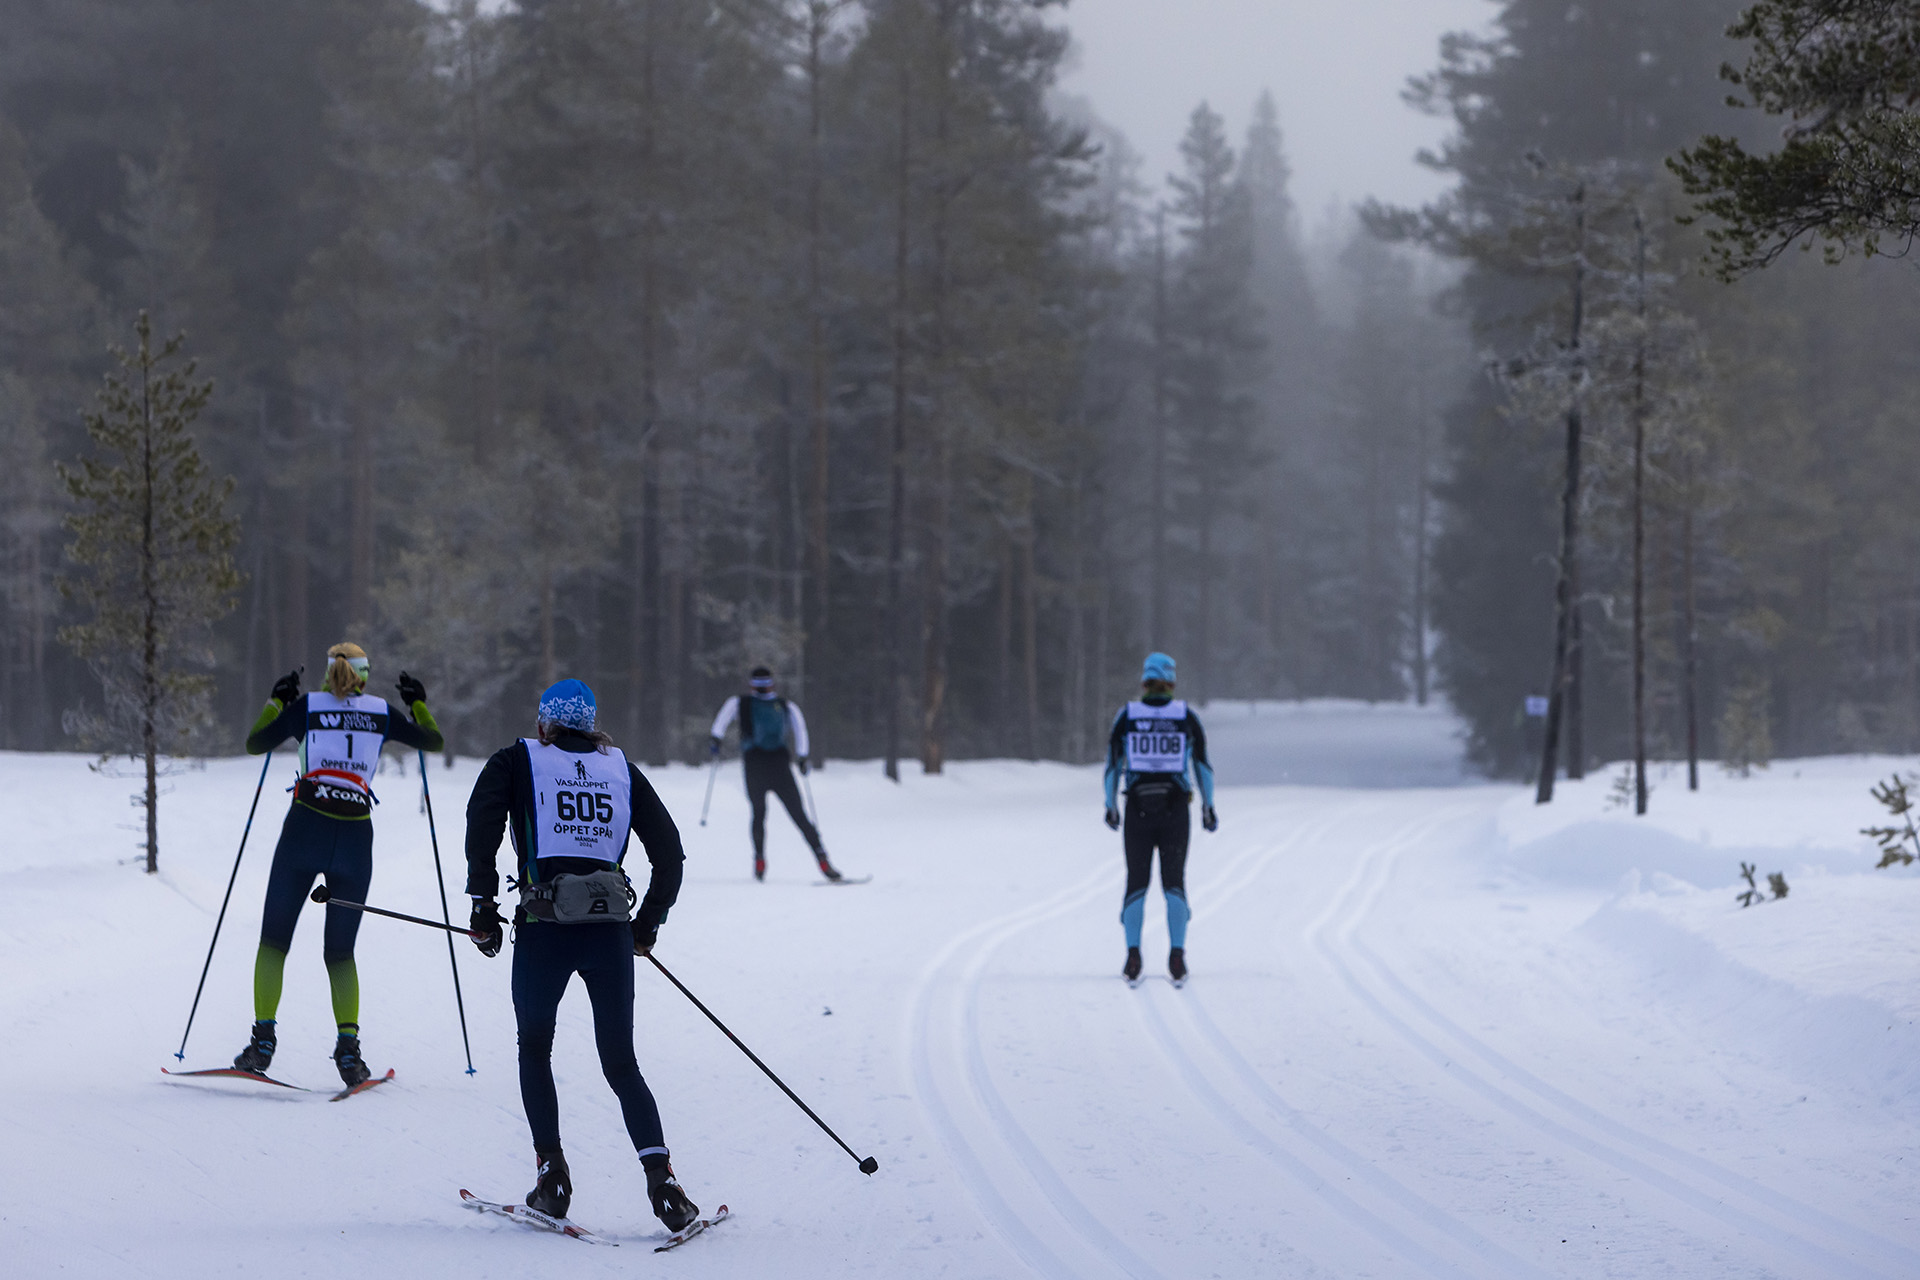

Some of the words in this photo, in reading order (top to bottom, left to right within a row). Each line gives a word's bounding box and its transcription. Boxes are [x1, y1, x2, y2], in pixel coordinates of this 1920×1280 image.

[343, 712, 371, 721] wibe
[343, 720, 377, 731] group
[344, 733, 353, 759] 1
[1132, 735, 1181, 755] 10108
[320, 758, 349, 770] ÖPPET
[555, 778, 609, 789] VASALOPPET
[331, 789, 367, 806] COXA
[556, 791, 613, 823] 605
[554, 822, 590, 834] ÖPPET
[593, 826, 613, 839] SPÅR
